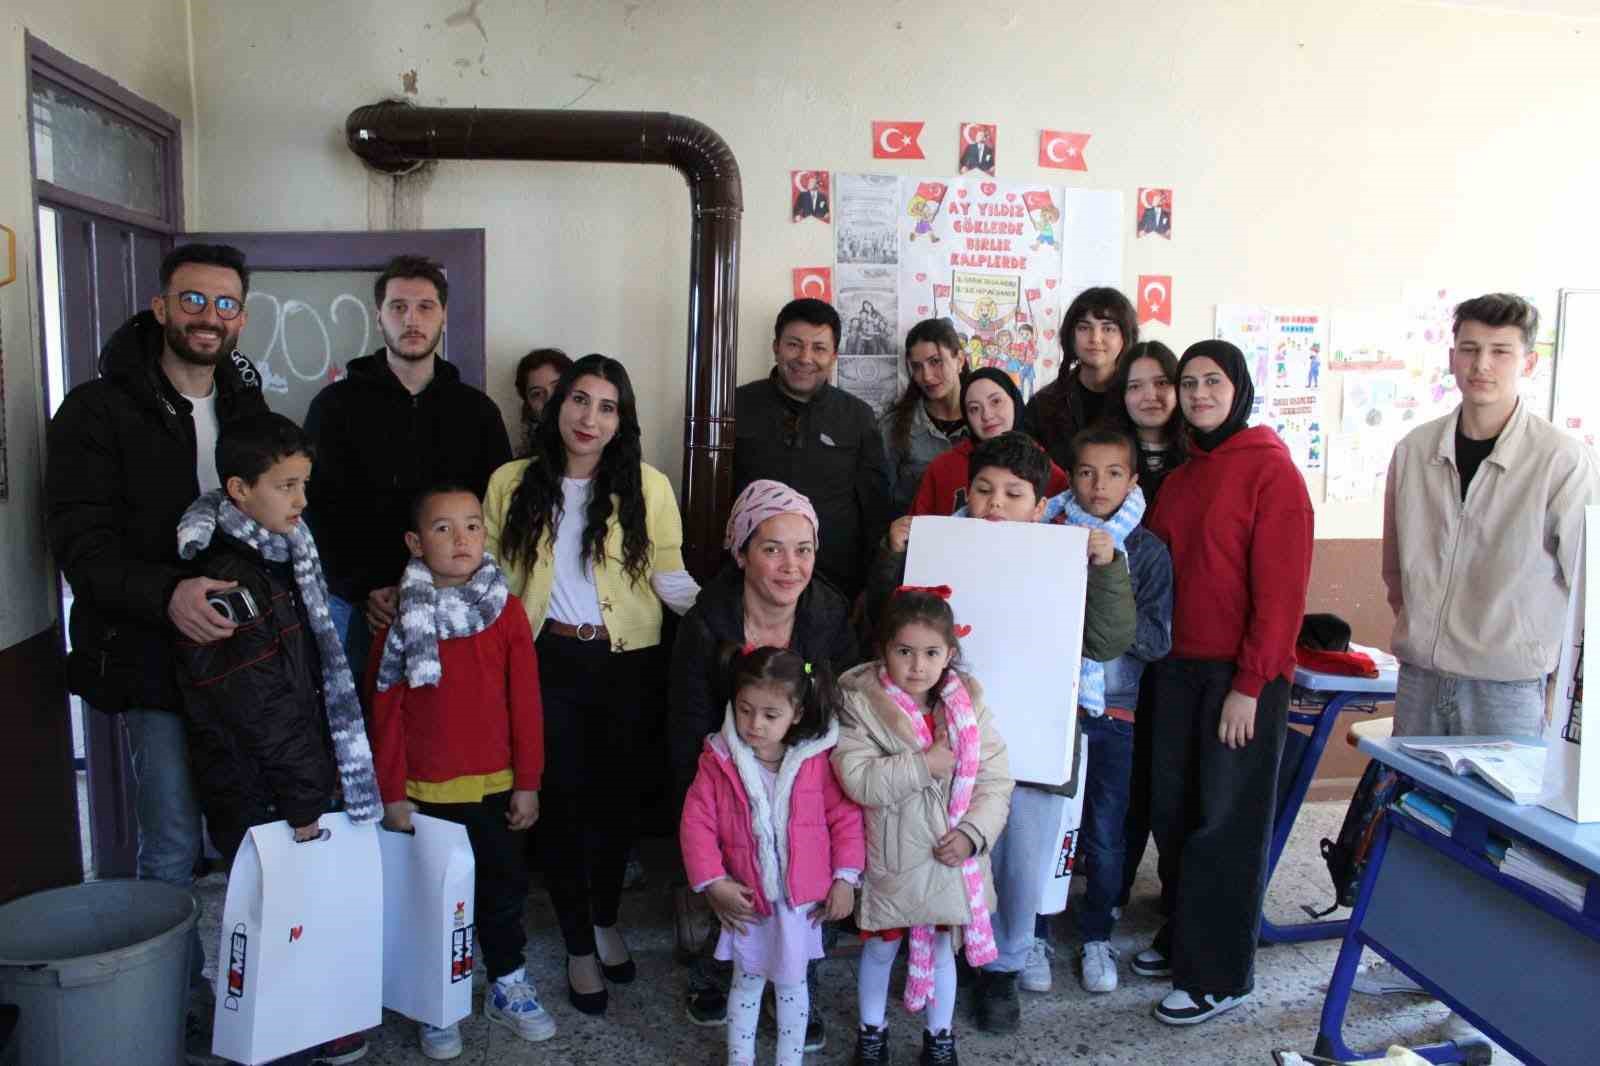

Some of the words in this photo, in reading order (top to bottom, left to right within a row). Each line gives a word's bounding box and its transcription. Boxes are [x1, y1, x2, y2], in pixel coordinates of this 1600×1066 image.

[949, 202, 970, 215] AY
[977, 203, 1024, 217] YILDIZ
[953, 217, 1024, 235] GÖKLERDE
[950, 253, 1026, 269] KALPLERDE
